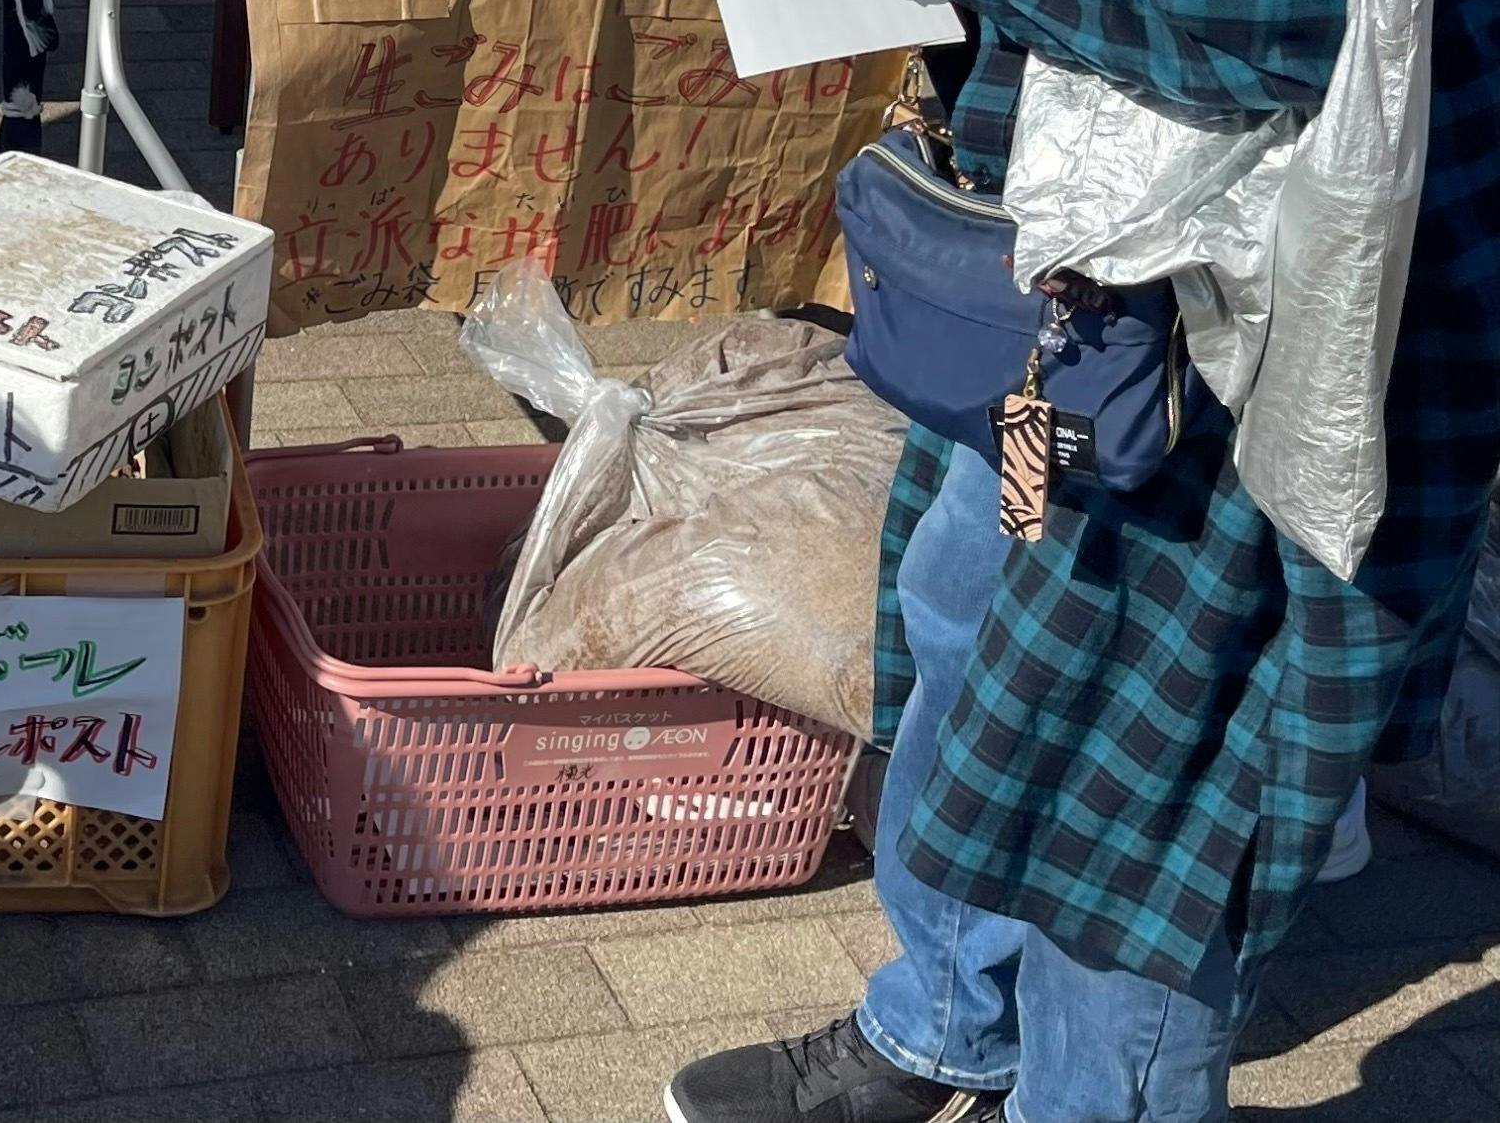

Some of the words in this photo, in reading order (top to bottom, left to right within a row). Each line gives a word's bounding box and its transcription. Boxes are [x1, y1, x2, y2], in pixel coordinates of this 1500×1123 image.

[111, 281, 238, 406] コンポスト
[579, 710, 674, 726] マイバスケット
[535, 728, 620, 754] singing
